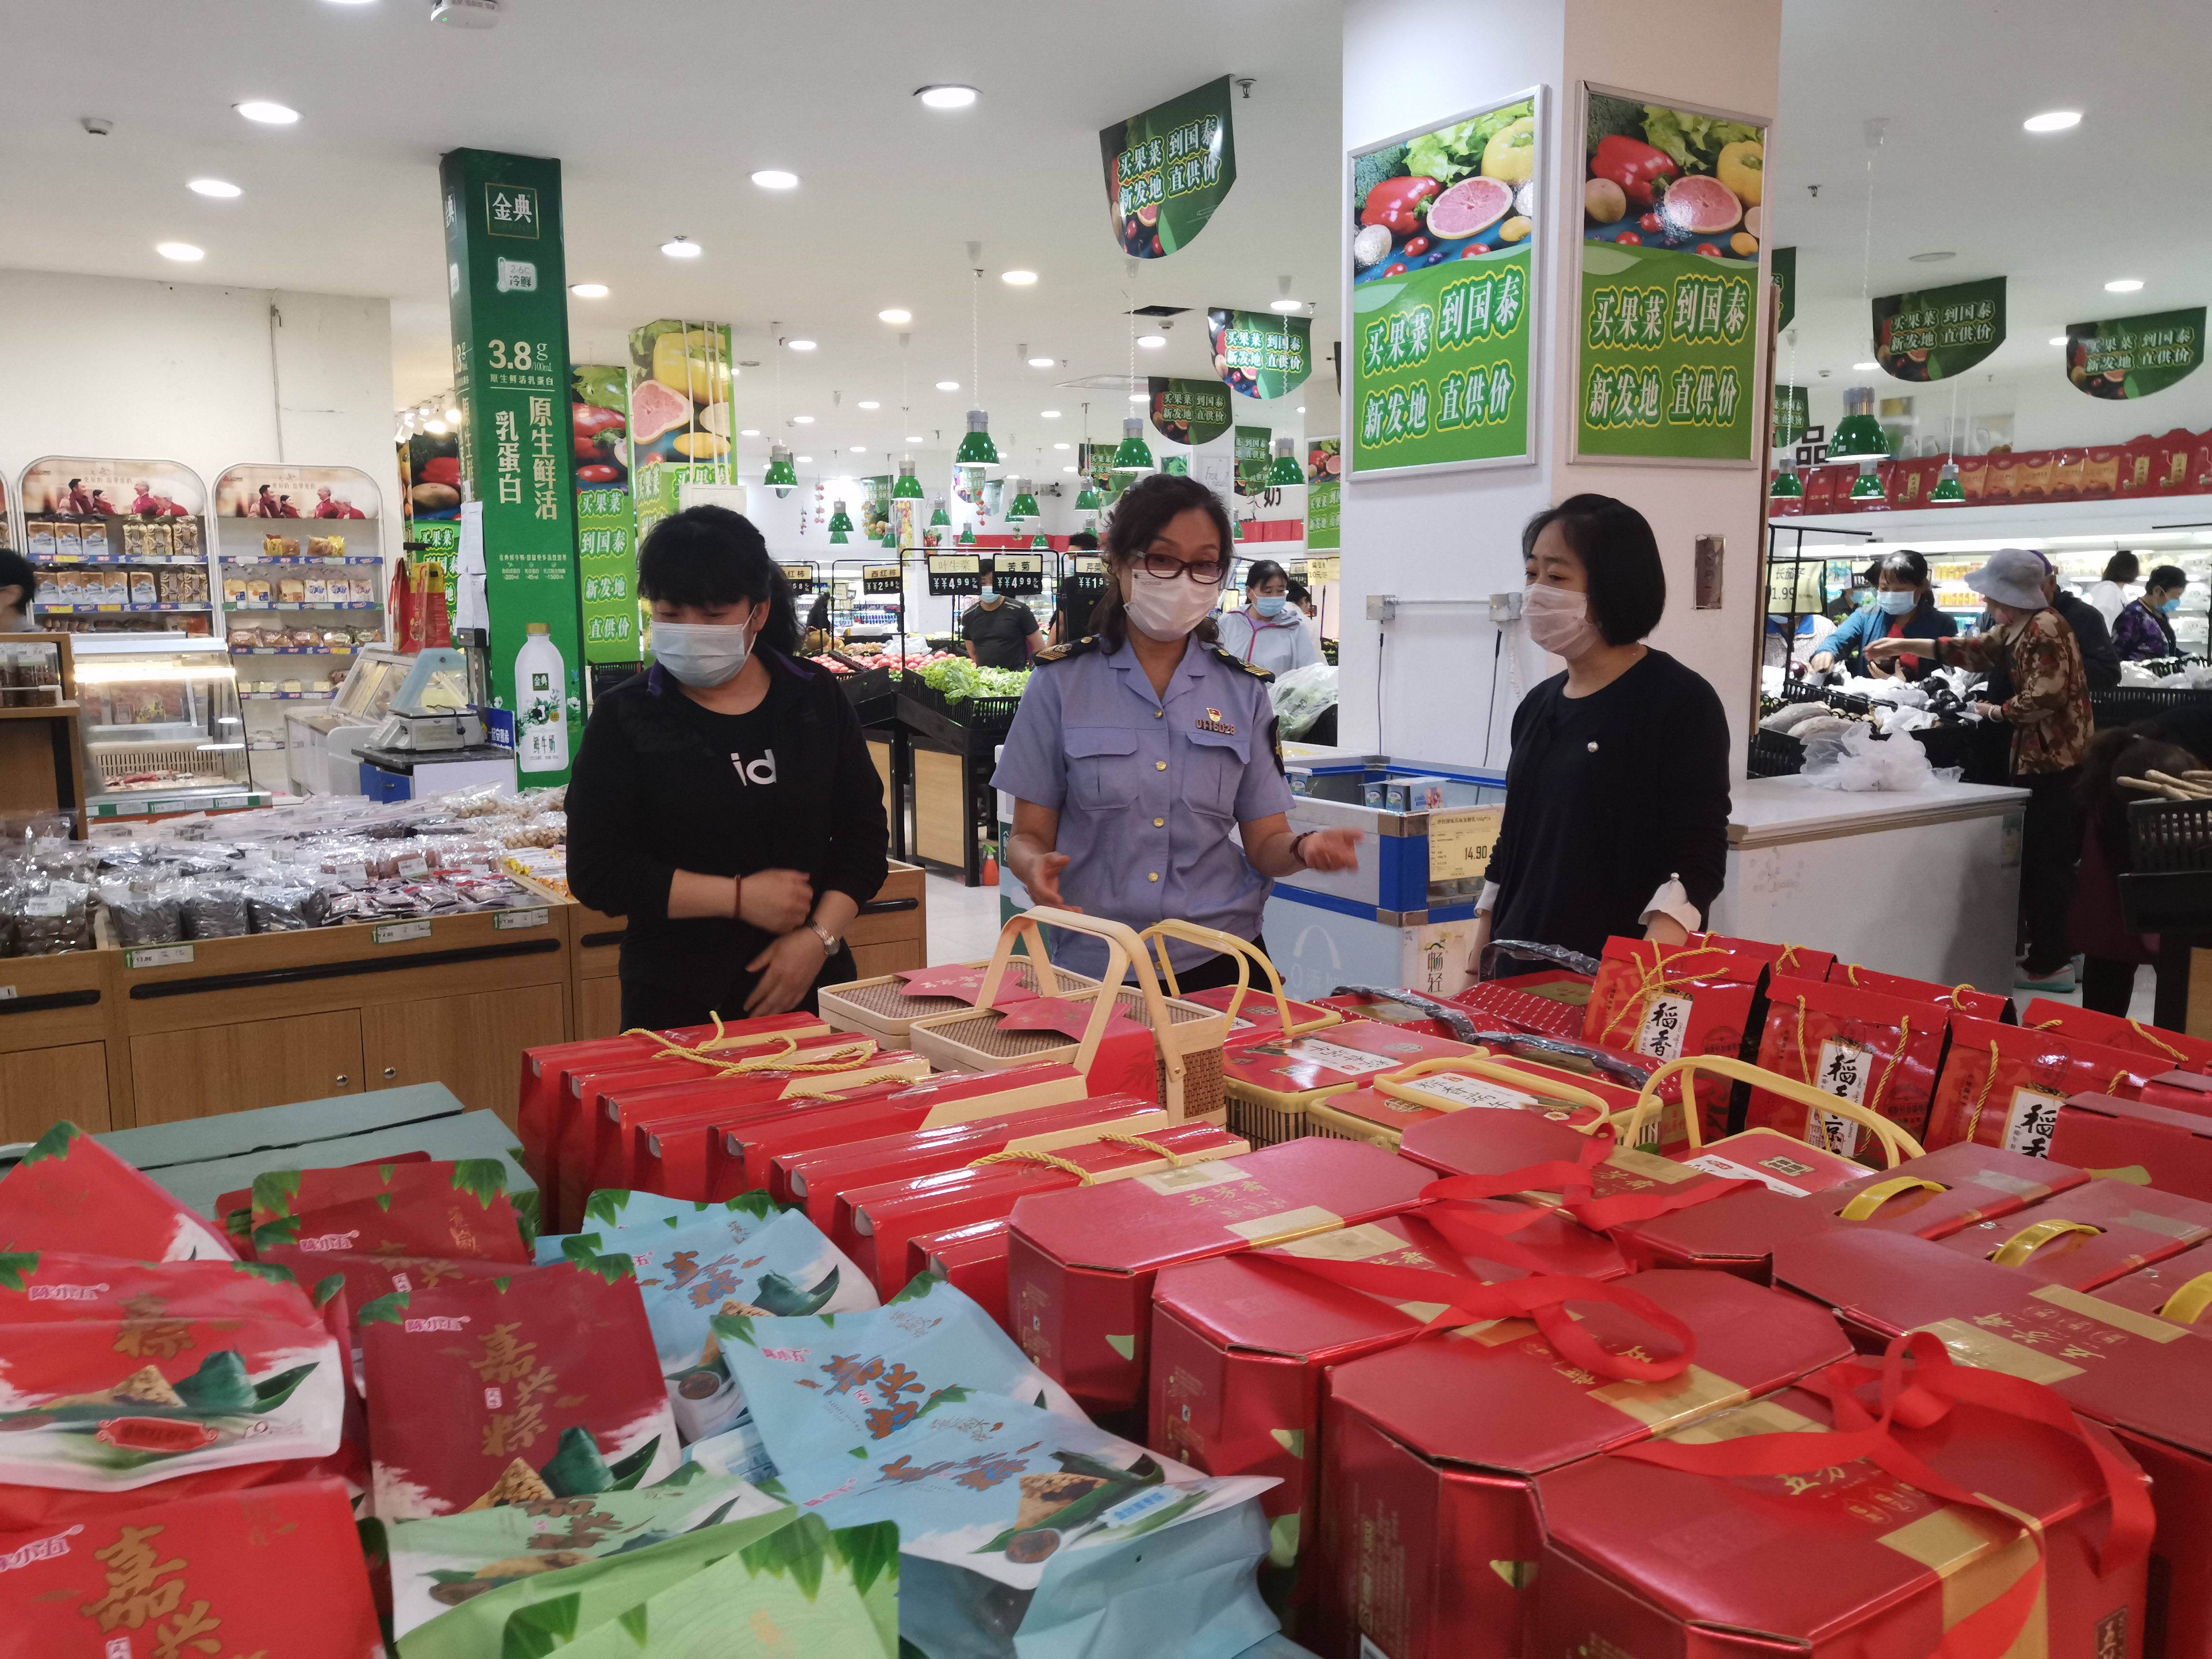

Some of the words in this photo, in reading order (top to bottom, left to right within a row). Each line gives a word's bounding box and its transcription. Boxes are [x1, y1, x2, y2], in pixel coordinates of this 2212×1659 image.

[1118, 136, 1163, 179] 买果菜
[1167, 118, 1219, 159] 到国泰
[1119, 176, 1164, 214] 新发地
[1168, 156, 1220, 192] 直供价
[492, 192, 532, 223] 金典
[1365, 312, 1430, 371] 买果菜
[1440, 274, 1520, 344] 到国泰
[1593, 290, 1666, 342] 买果菜
[1674, 277, 1747, 336] 到国泰
[1891, 308, 1937, 331] 买果菜
[1943, 302, 1993, 325] 到国泰
[1226, 329, 1262, 349] 买果菜
[1266, 333, 1302, 352] 到国泰
[1890, 331, 1937, 352] 新发地
[1944, 324, 1993, 346] 直供价
[2085, 334, 2134, 355] 买果菜
[2141, 328, 2191, 348] 到国泰
[1226, 349, 1262, 368] 新发地
[1265, 354, 1302, 371] 直供价
[2085, 353, 2133, 373] 新发地
[2141, 347, 2191, 366] 直供价
[1163, 392, 1193, 408] 买果菜
[1196, 393, 1225, 409] 到国泰
[1363, 388, 1428, 442] 新发地
[1440, 367, 1512, 426] 直供价
[1589, 372, 1661, 421] 新发地
[1671, 372, 1738, 419] 直供价
[1163, 408, 1193, 422] 新发地
[1196, 409, 1226, 423] 直供价
[494, 410, 522, 505] 乳蛋白
[529, 396, 558, 520] 原生鲜活
[580, 491, 623, 516] 买果菜
[581, 529, 626, 555] 到国泰
[871, 569, 897, 578] 西红柿
[938, 559, 971, 572] 叶生菜
[1007, 561, 1031, 573] 苦菊
[585, 577, 625, 600] 新发地
[589, 616, 631, 640] 直供价
[1195, 718, 1237, 735] 0116028
[730, 748, 777, 787] id
[1465, 845, 1488, 861] 14.90
[1649, 1001, 1678, 1057] 稻香
